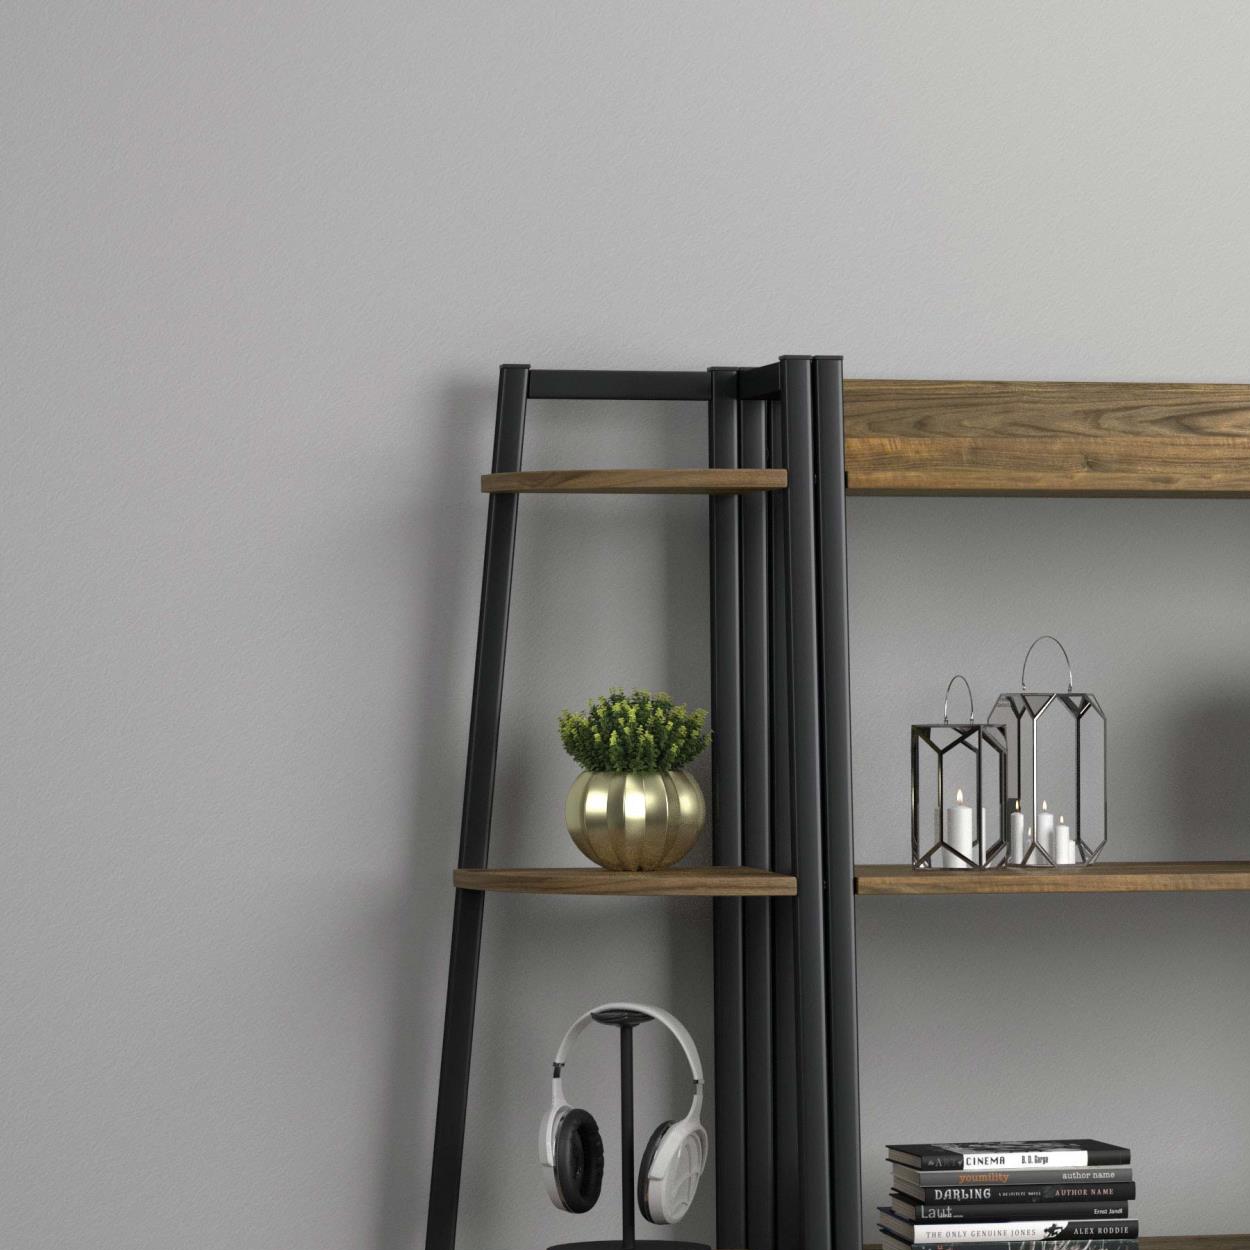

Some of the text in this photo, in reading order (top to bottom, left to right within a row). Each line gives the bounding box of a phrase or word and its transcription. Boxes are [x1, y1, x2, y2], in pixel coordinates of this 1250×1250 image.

[966, 1156, 1006, 1166] CINEMA
[959, 1172, 1009, 1184] youmility
[1092, 1171, 1115, 1179] name
[935, 1188, 991, 1201] DARLING
[946, 1230, 967, 1238] ONLY
[971, 1229, 1008, 1237] GENUINE
[1010, 1229, 1035, 1237] JONES
[1073, 1227, 1094, 1235] ALEX
[1098, 1226, 1128, 1234] RODDIE
